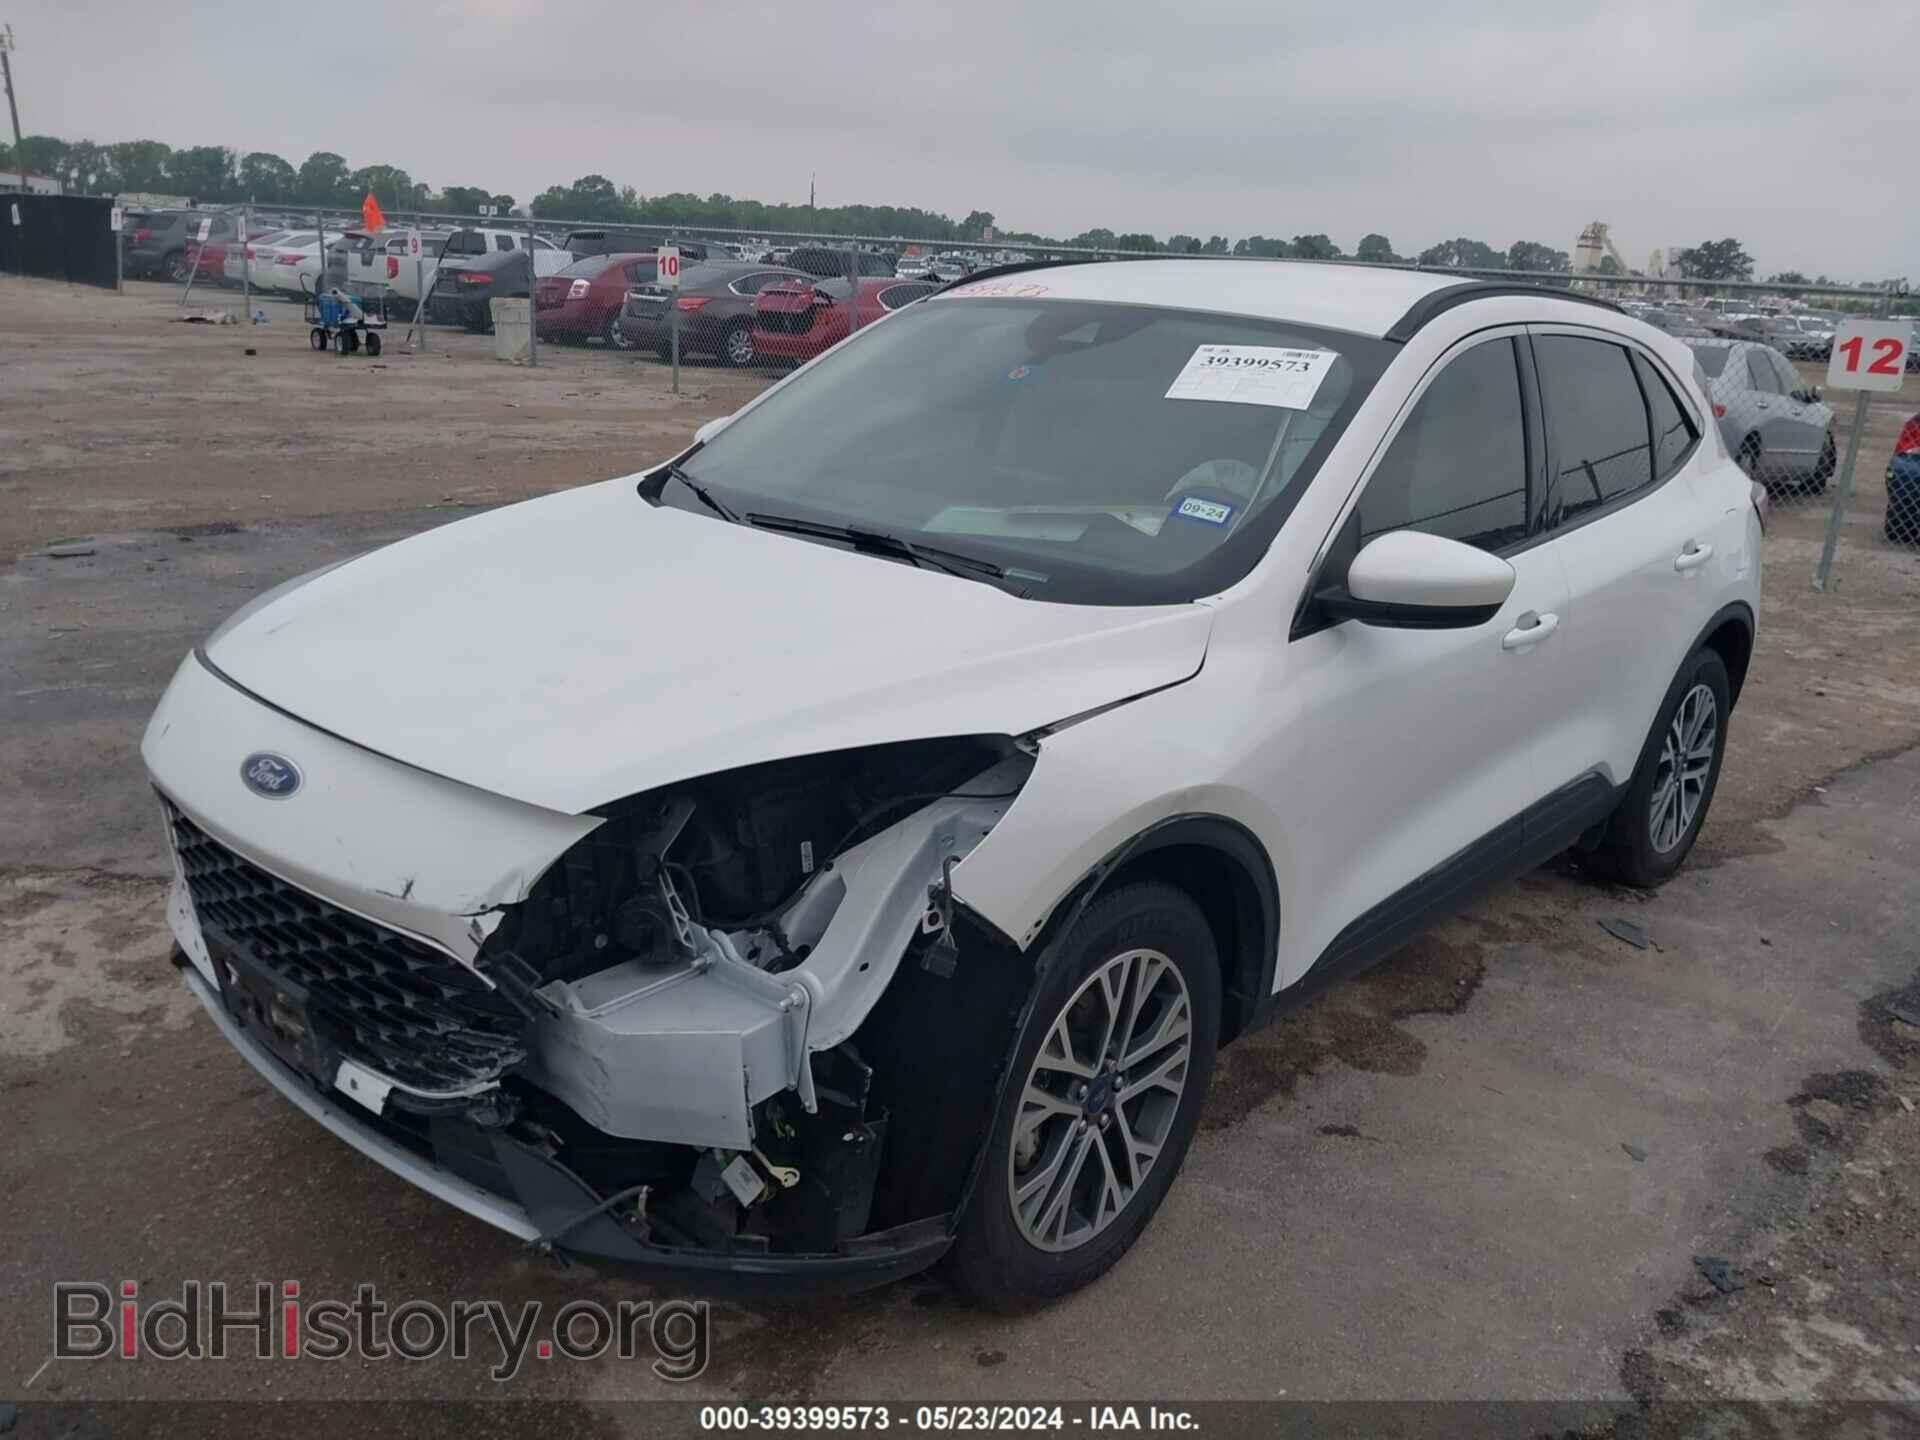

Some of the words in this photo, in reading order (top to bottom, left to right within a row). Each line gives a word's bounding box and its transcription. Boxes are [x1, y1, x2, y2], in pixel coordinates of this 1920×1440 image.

[411, 237, 418, 254] 9
[659, 255, 678, 276] 10
[1199, 355, 1311, 373] 39399573
[1839, 336, 1904, 376] 12
[249, 759, 289, 790] Ford
